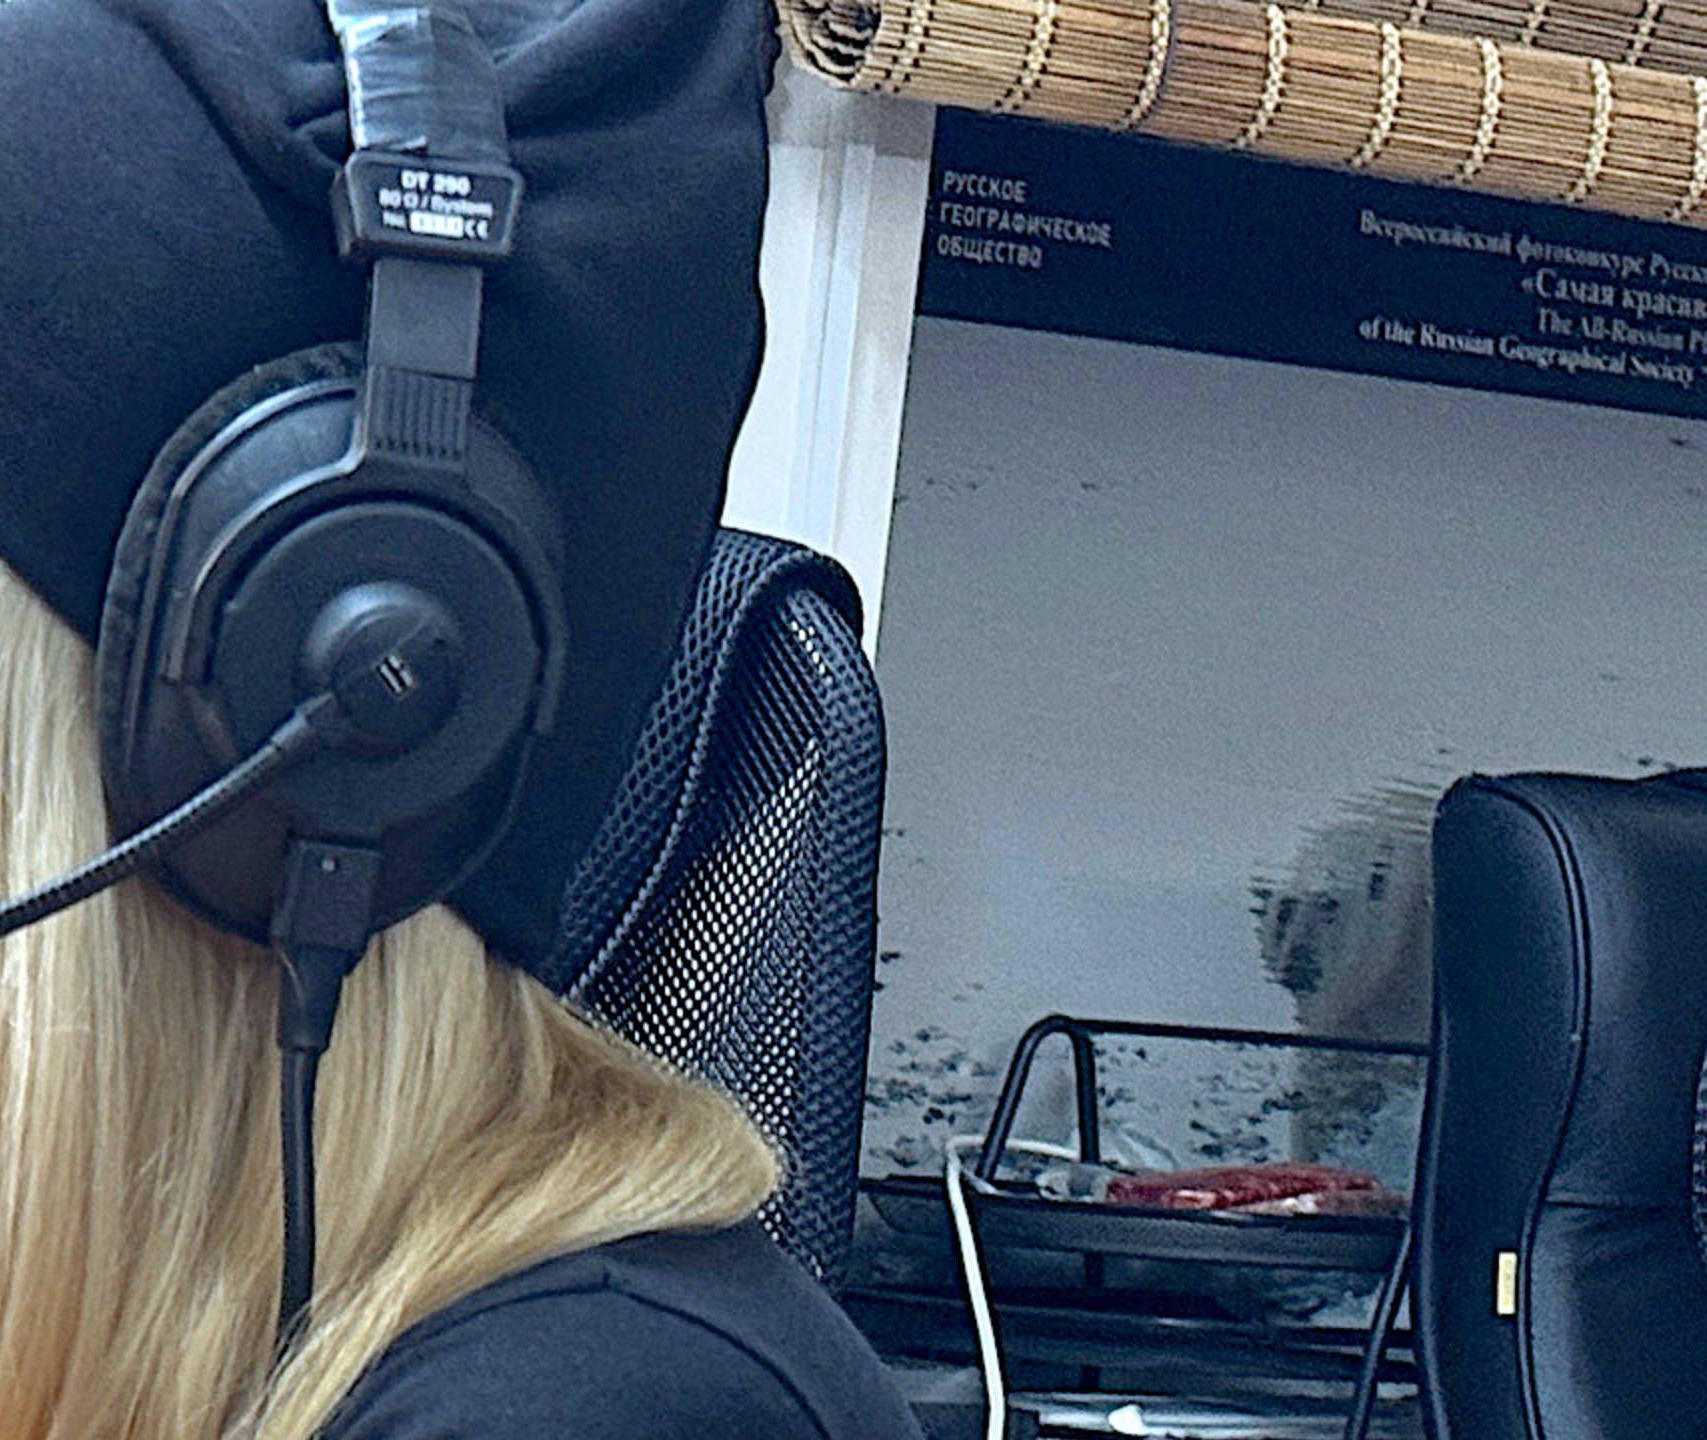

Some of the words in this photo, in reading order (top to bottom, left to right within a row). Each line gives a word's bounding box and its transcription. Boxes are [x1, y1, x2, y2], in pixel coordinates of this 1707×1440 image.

[942, 170, 1028, 204] РУССКОЕ
[939, 202, 1114, 249] ГЕОГРАФИЧЕСКОЕ
[937, 233, 1044, 269] ОБЩЕСТВО
[1420, 321, 1495, 357] Russian
